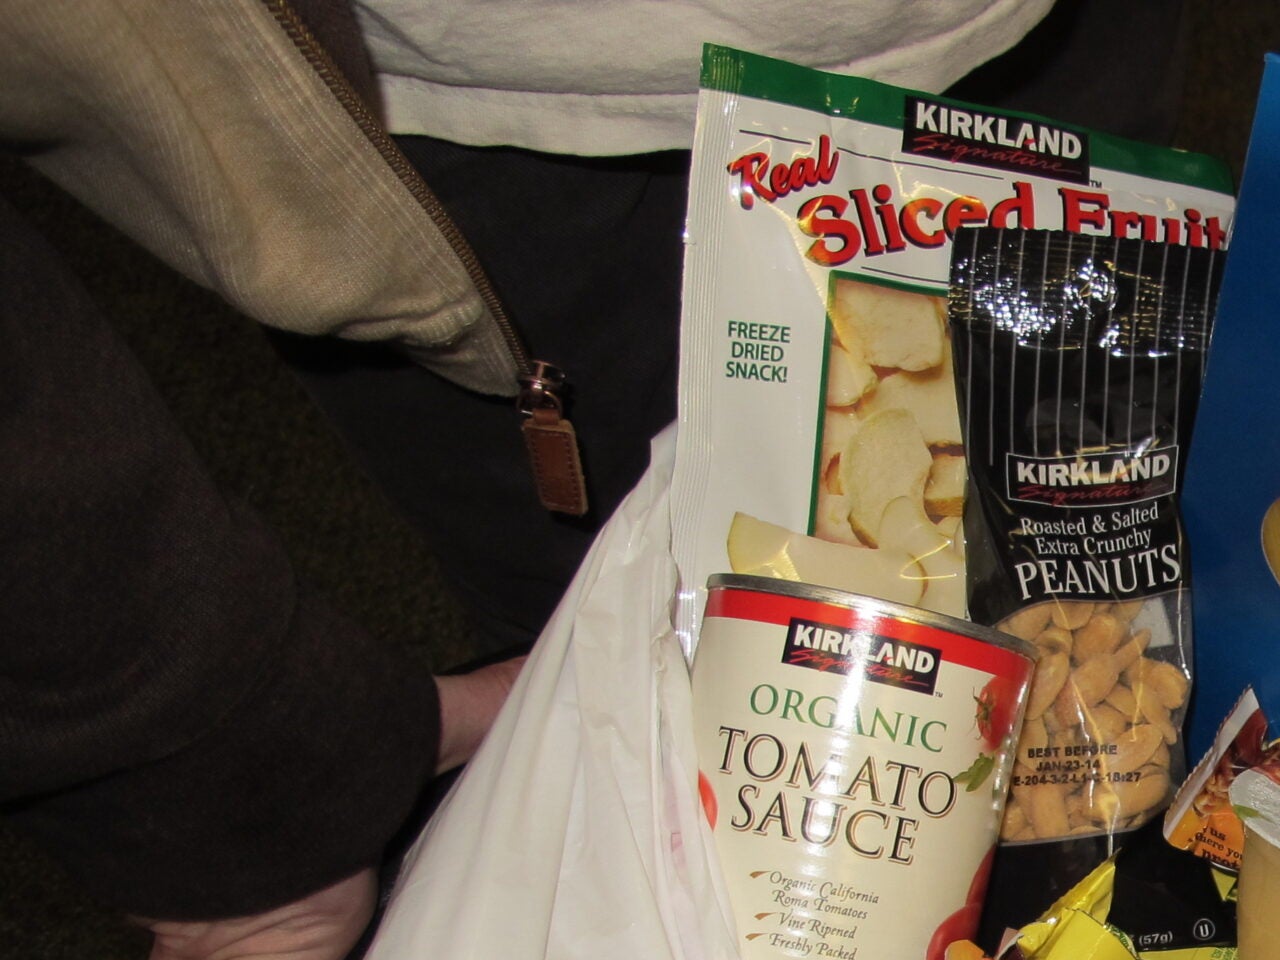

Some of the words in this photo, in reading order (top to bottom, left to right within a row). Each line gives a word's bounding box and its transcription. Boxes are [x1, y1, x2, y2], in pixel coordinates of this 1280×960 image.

[914, 101, 1083, 161] KIRKLAND
[728, 134, 839, 211] Real
[797, 181, 1035, 268] Sliced
[1058, 186, 1231, 251] Fruit
[727, 319, 791, 344] FREEZE
[731, 342, 784, 362] DRIED
[725, 361, 788, 383] SNACK!
[1016, 454, 1171, 487] KIRKLAND
[1020, 516, 1087, 536] Roasted
[1092, 514, 1107, 533] &
[1112, 501, 1159, 531] Salted
[1035, 537, 1081, 555] Extra
[1083, 528, 1152, 555] Crunchy
[1014, 544, 1181, 600] PEANUTS
[793, 623, 935, 674] KIRKLAND
[750, 683, 948, 753] ORGANIC
[1027, 747, 1061, 758] BEST
[1064, 745, 1118, 757] BEFORE
[718, 726, 959, 817] TOMATO
[730, 784, 920, 865] SAUCE
[769, 871, 817, 892] Organic
[820, 881, 880, 904] California
[772, 889, 808, 909] Roma
[813, 898, 868, 920] Tomatoes
[777, 911, 806, 930] Vine
[808, 919, 857, 940] Ripened
[1139, 930, 1174, 946] (57g)
[769, 933, 813, 955] Freshly
